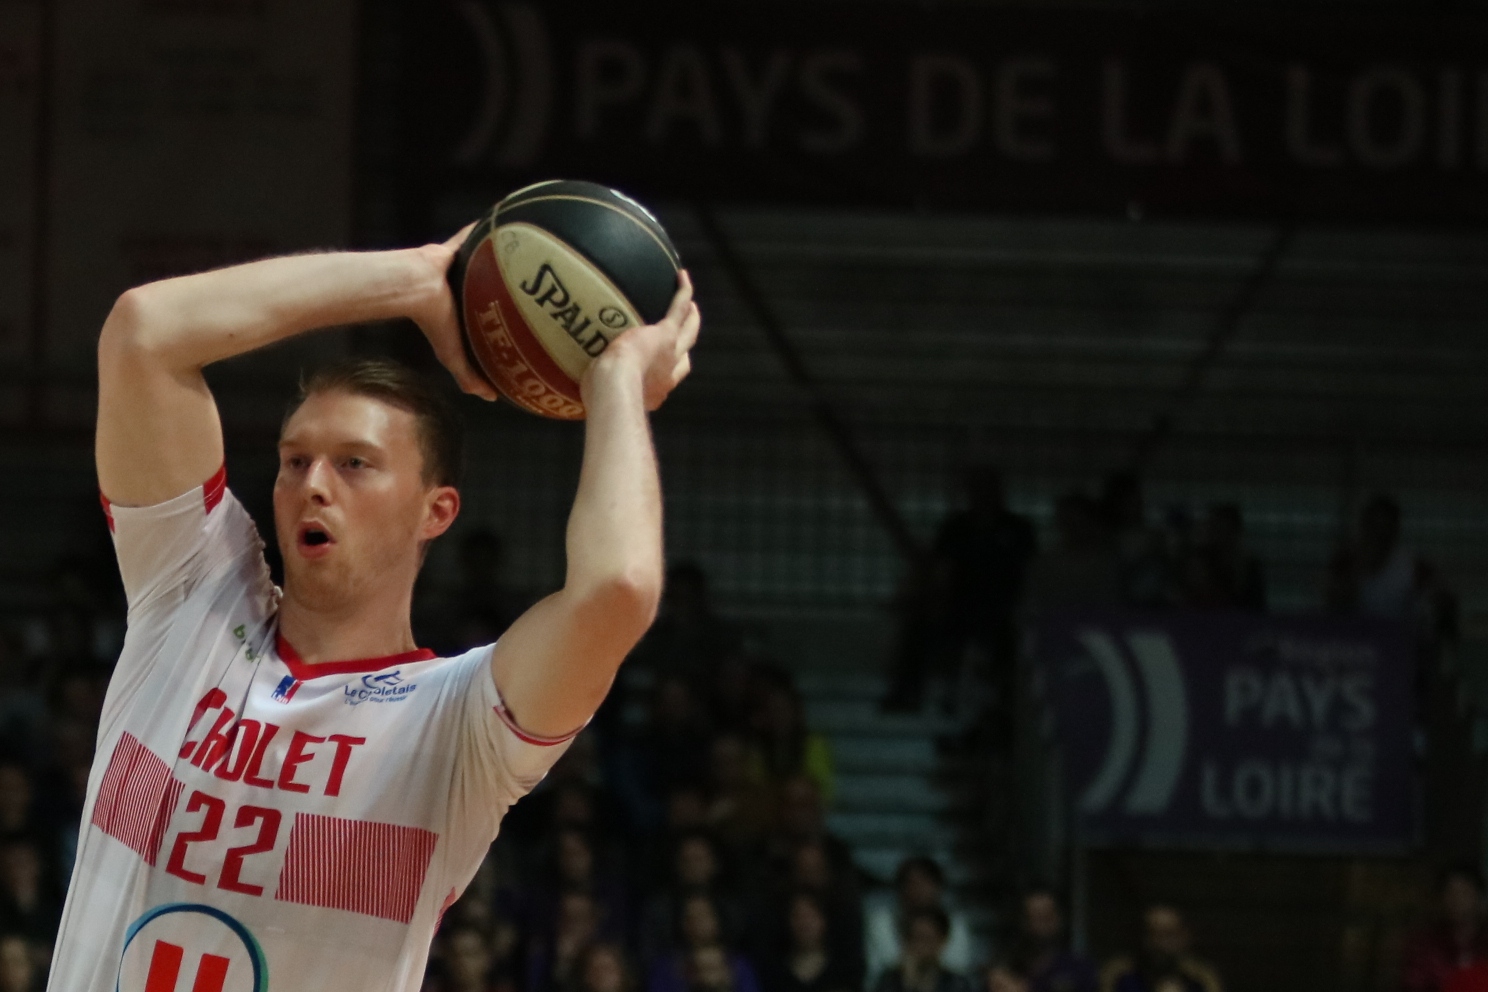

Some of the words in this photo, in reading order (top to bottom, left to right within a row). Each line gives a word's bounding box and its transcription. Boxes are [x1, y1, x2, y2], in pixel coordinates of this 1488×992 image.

[572, 39, 868, 158] PAYS
[909, 52, 1058, 162] DE
[1100, 55, 1244, 168] LA
[178, 687, 367, 797] CHOLET
[1223, 664, 1379, 732] PAYS
[165, 790, 282, 897] 22
[1200, 758, 1375, 823] LOIRE
